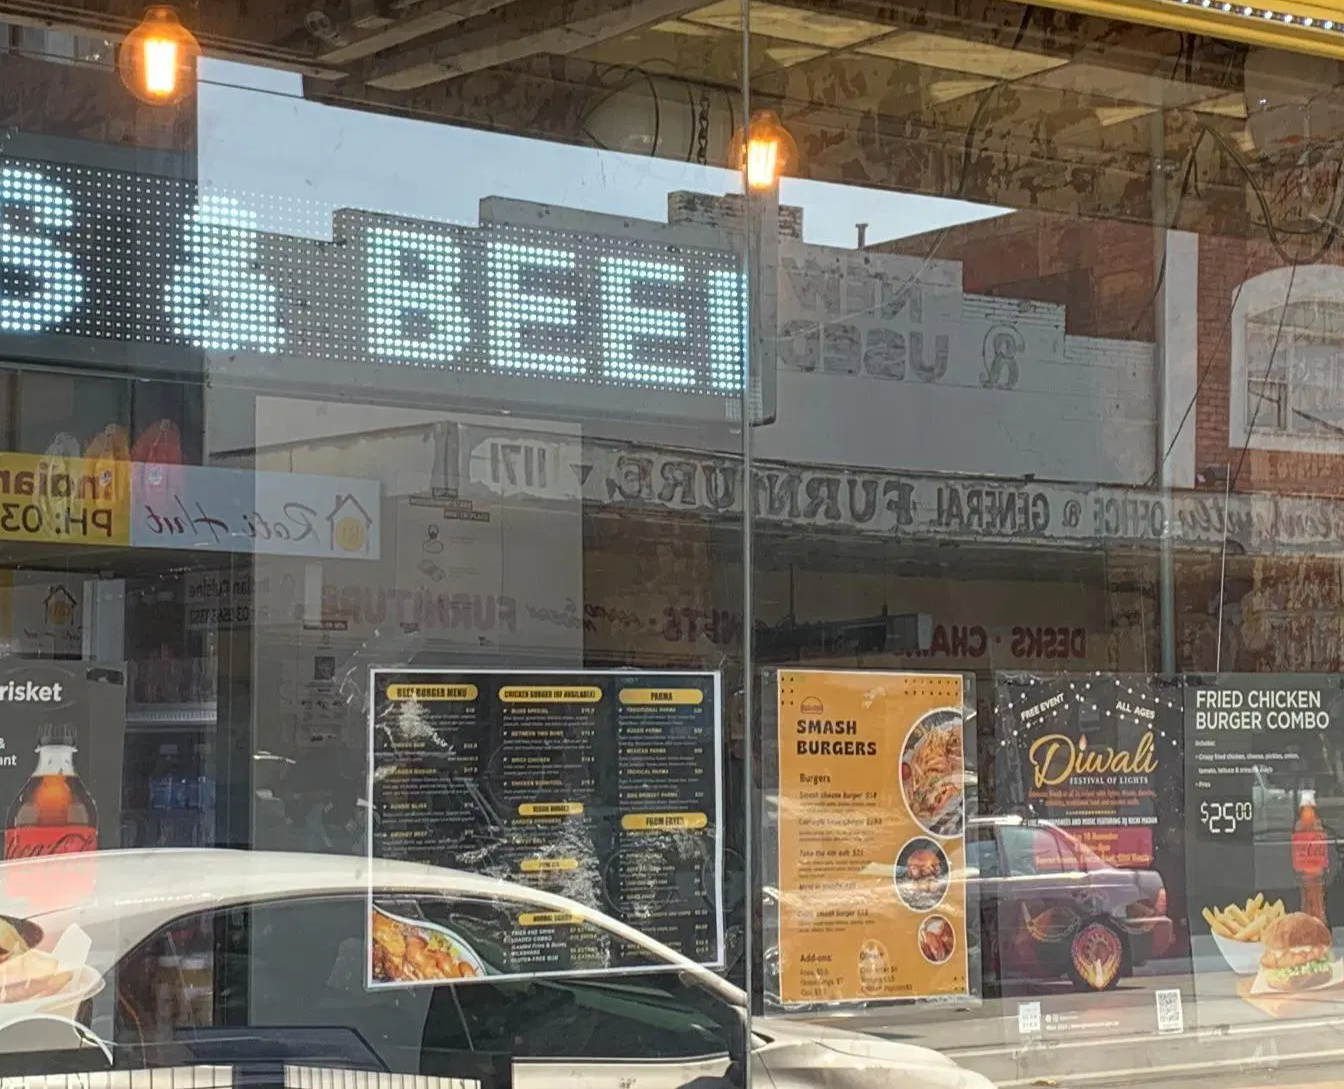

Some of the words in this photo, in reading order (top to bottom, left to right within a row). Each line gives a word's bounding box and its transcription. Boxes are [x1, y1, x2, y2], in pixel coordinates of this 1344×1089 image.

[164, 194, 285, 354] &
[416, 688, 446, 698] BURGER
[447, 687, 468, 698] MENU
[650, 692, 673, 701] PARMA
[1196, 690, 1243, 708] FRIED
[1248, 690, 1321, 708] CHICKEN
[1021, 706, 1041, 721] FREE
[1040, 693, 1065, 714] EVENT
[1116, 700, 1132, 713] ALL
[1134, 706, 1156, 719] AGES
[797, 719, 857, 735] SMASH
[1196, 712, 1262, 729] BURGER
[1267, 711, 1330, 729] COMBO
[796, 741, 877, 755] BURGERS
[1029, 731, 1158, 788] Diwali
[799, 774, 831, 785] Burgers
[1070, 776, 1105, 785] FESTIVAL
[1107, 776, 1118, 785] OF
[1119, 776, 1149, 785] LIGHTS
